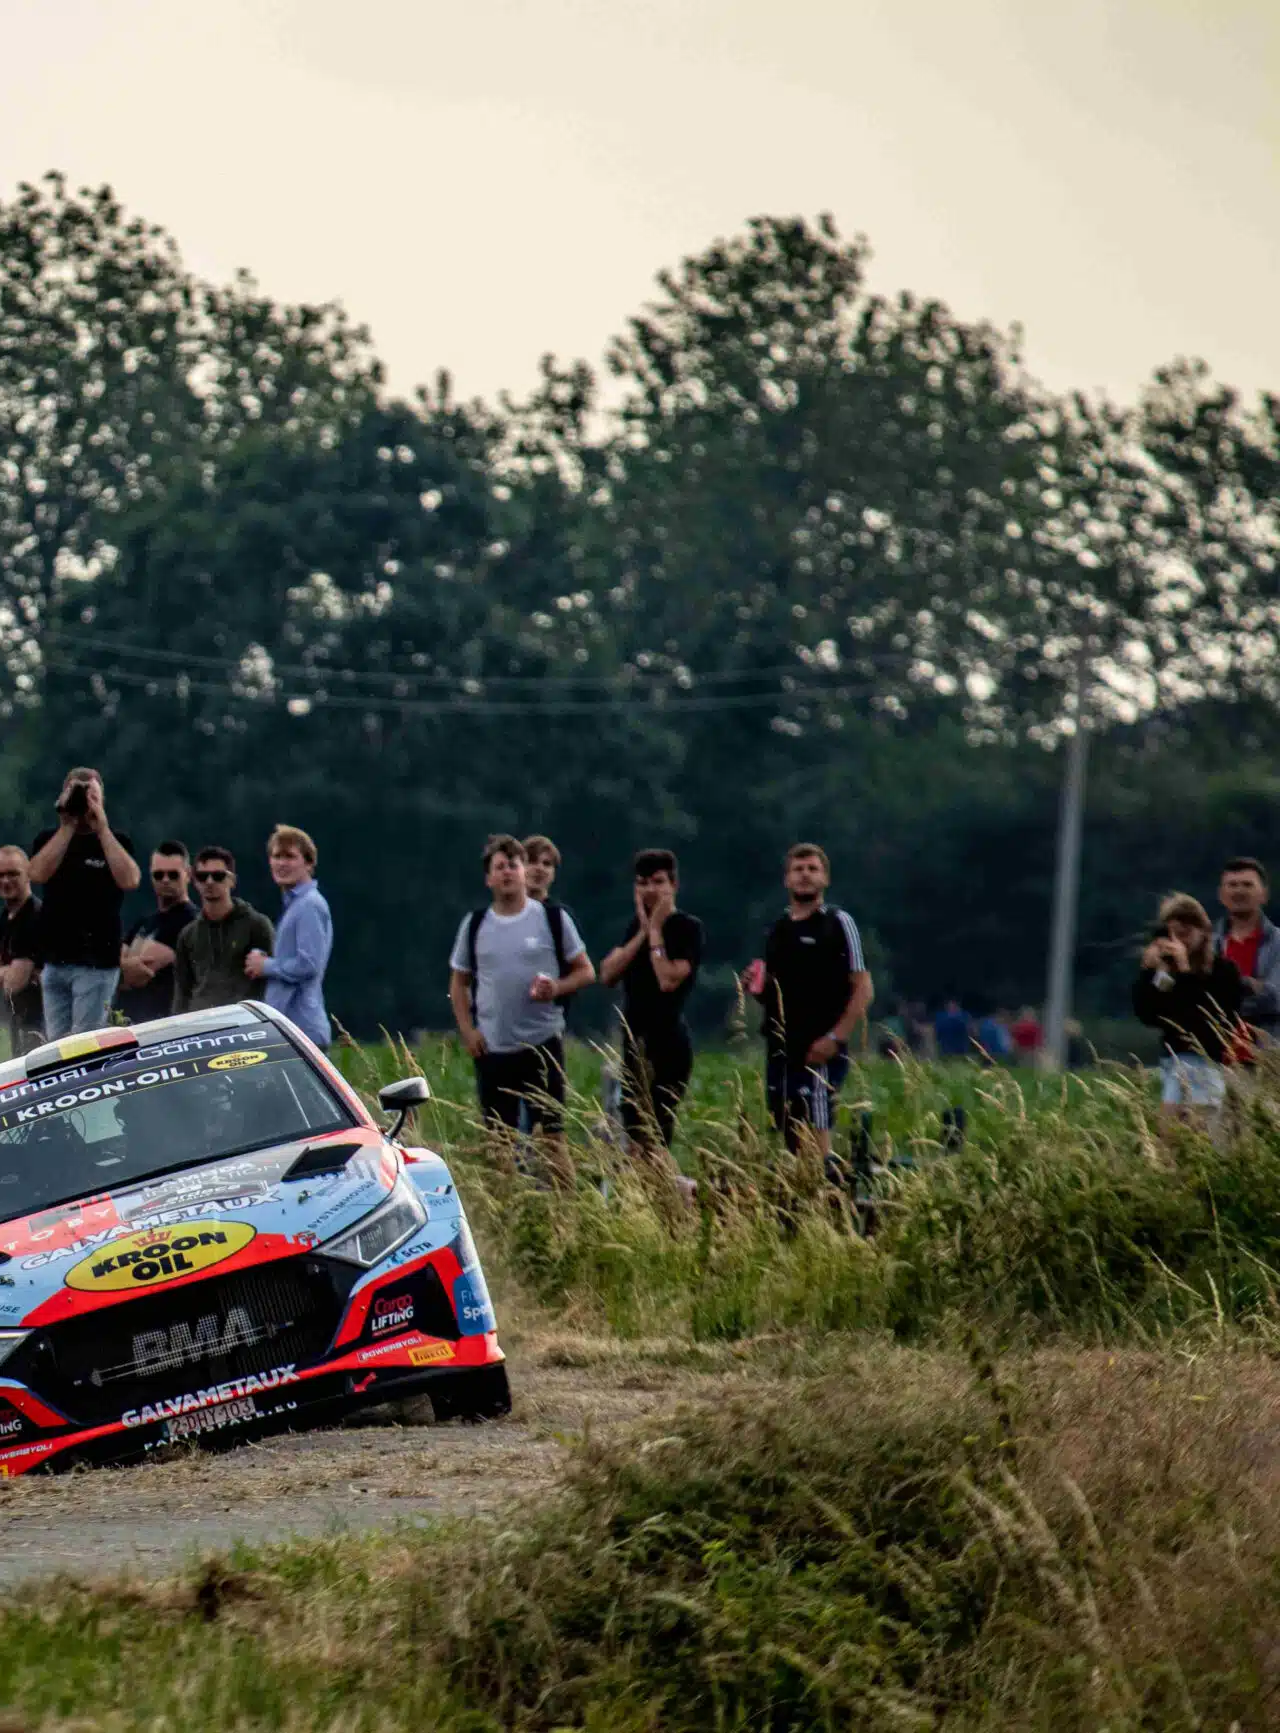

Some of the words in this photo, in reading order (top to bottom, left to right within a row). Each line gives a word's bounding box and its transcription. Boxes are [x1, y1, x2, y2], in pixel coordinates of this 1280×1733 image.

[216, 1054, 259, 1066] KROON
[229, 1060, 248, 1068] OIL
[17, 1067, 185, 1122] KROON-OIL
[21, 1185, 283, 1269] GALVAMETAUX
[92, 1231, 227, 1278] KROON
[132, 1253, 193, 1281] OIL
[121, 1363, 300, 1428] GALVAMETAUX
[172, 1401, 252, 1435] 2-DHY-103
